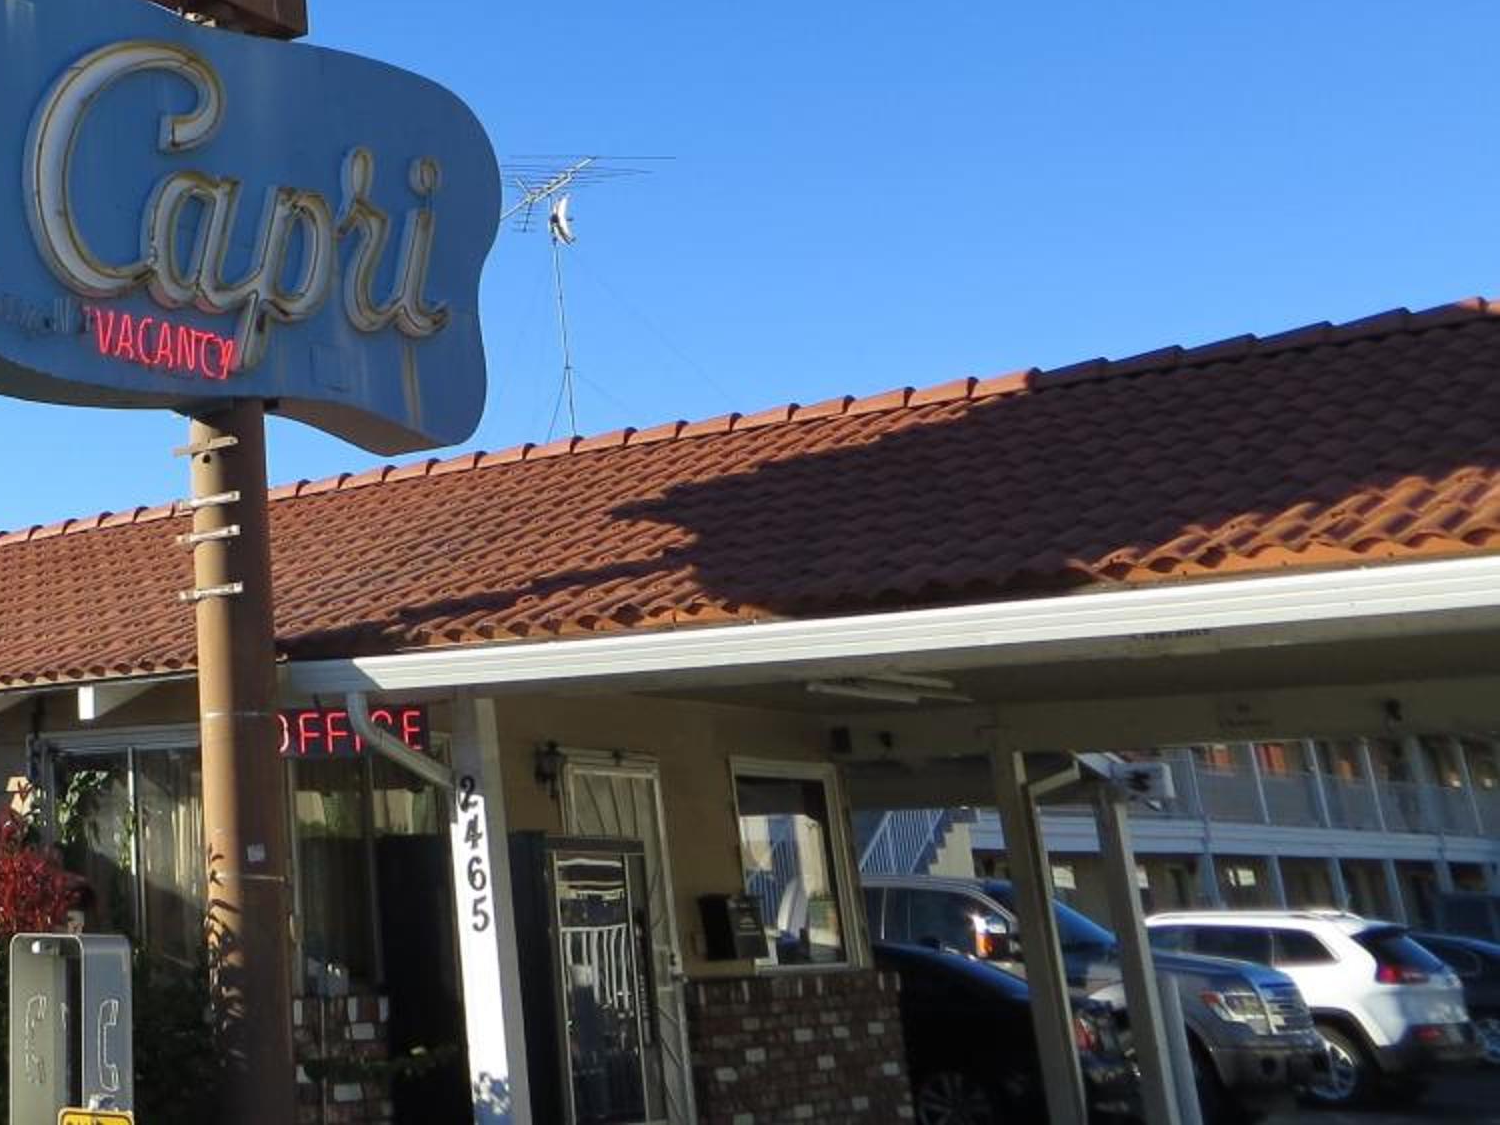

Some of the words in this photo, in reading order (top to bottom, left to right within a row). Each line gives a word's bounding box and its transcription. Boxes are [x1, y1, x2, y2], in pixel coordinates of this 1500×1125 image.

[23, 38, 451, 370] Capri
[92, 305, 238, 380] VACANCY
[459, 775, 491, 933] 2465
